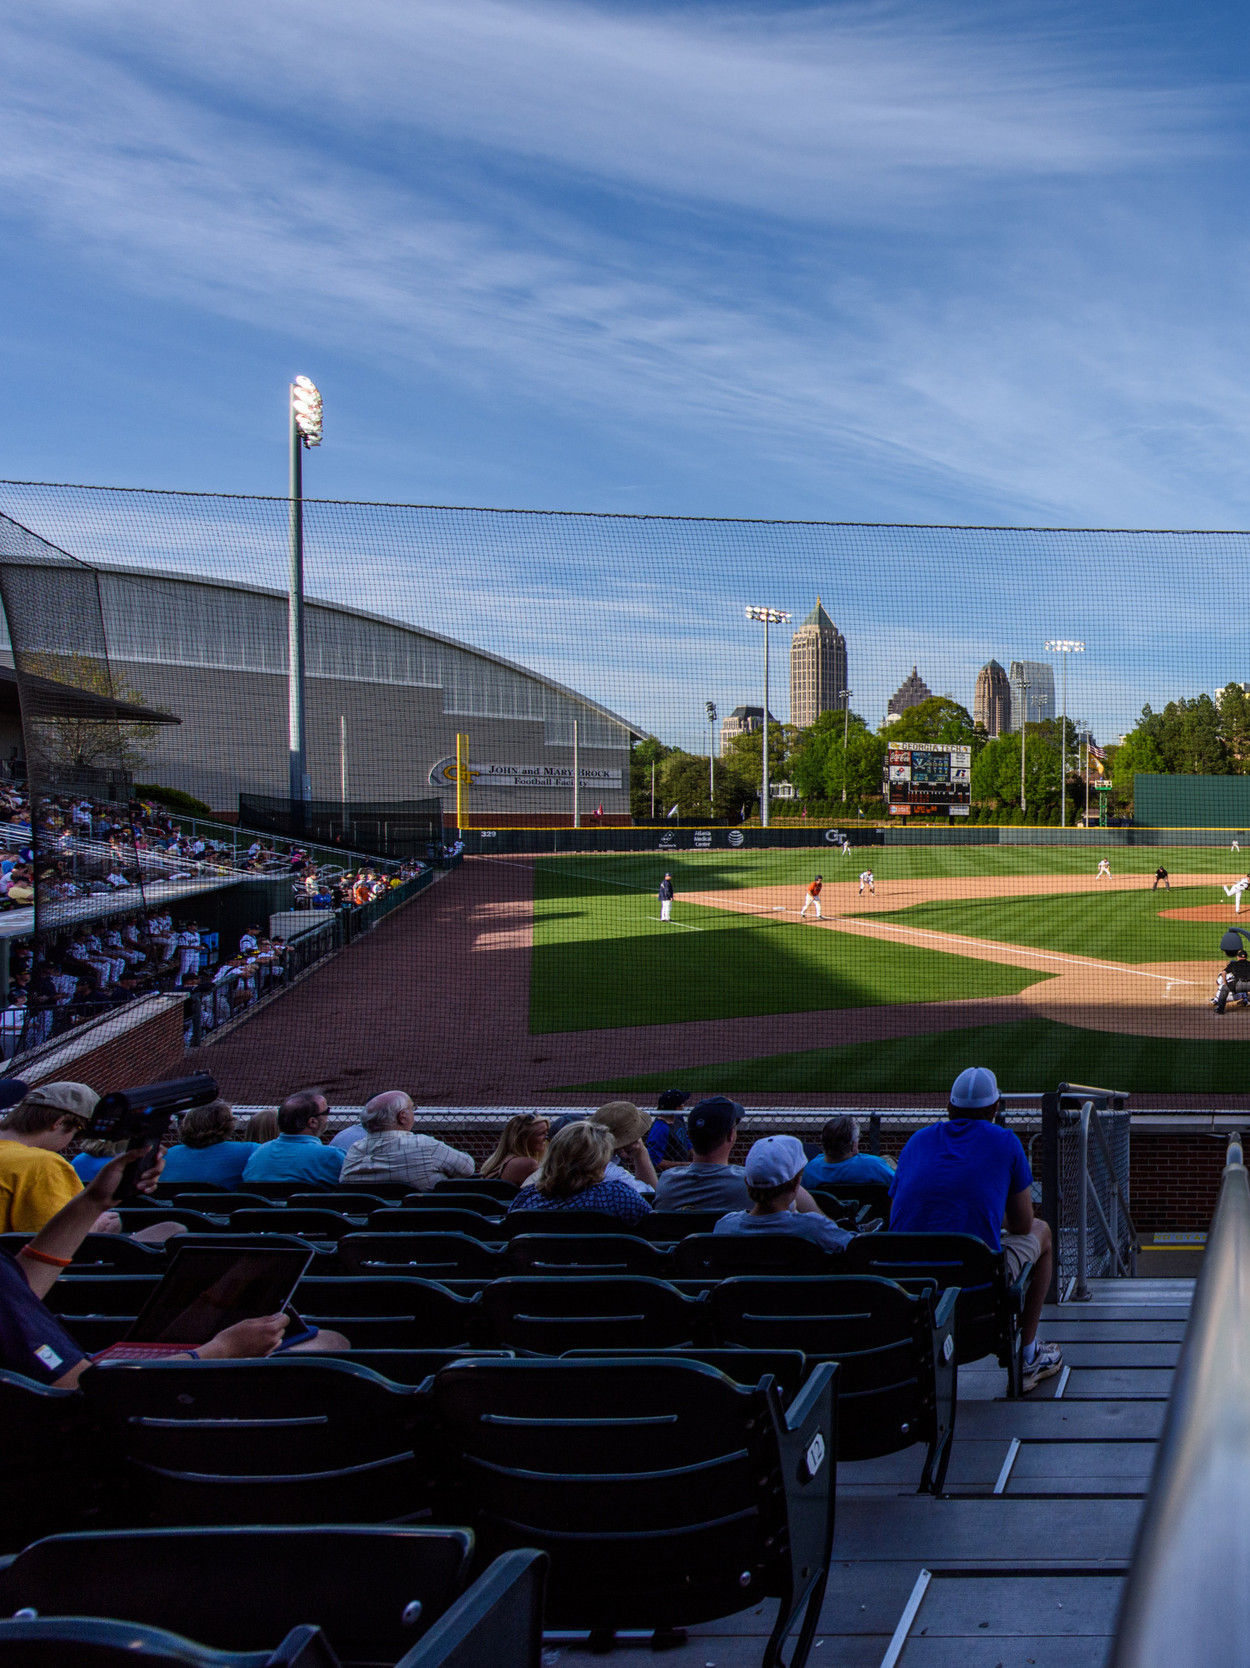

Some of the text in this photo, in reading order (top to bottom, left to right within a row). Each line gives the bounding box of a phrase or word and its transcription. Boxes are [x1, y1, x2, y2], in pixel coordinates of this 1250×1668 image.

[902, 742, 938, 752] GEORGIA
[488, 766, 518, 774] JOHN
[522, 767, 540, 775] and
[544, 767, 574, 776] MARY
[514, 778, 588, 787] Football Facity
[826, 829, 847, 844] GT
[811, 1440, 822, 1466] 12
